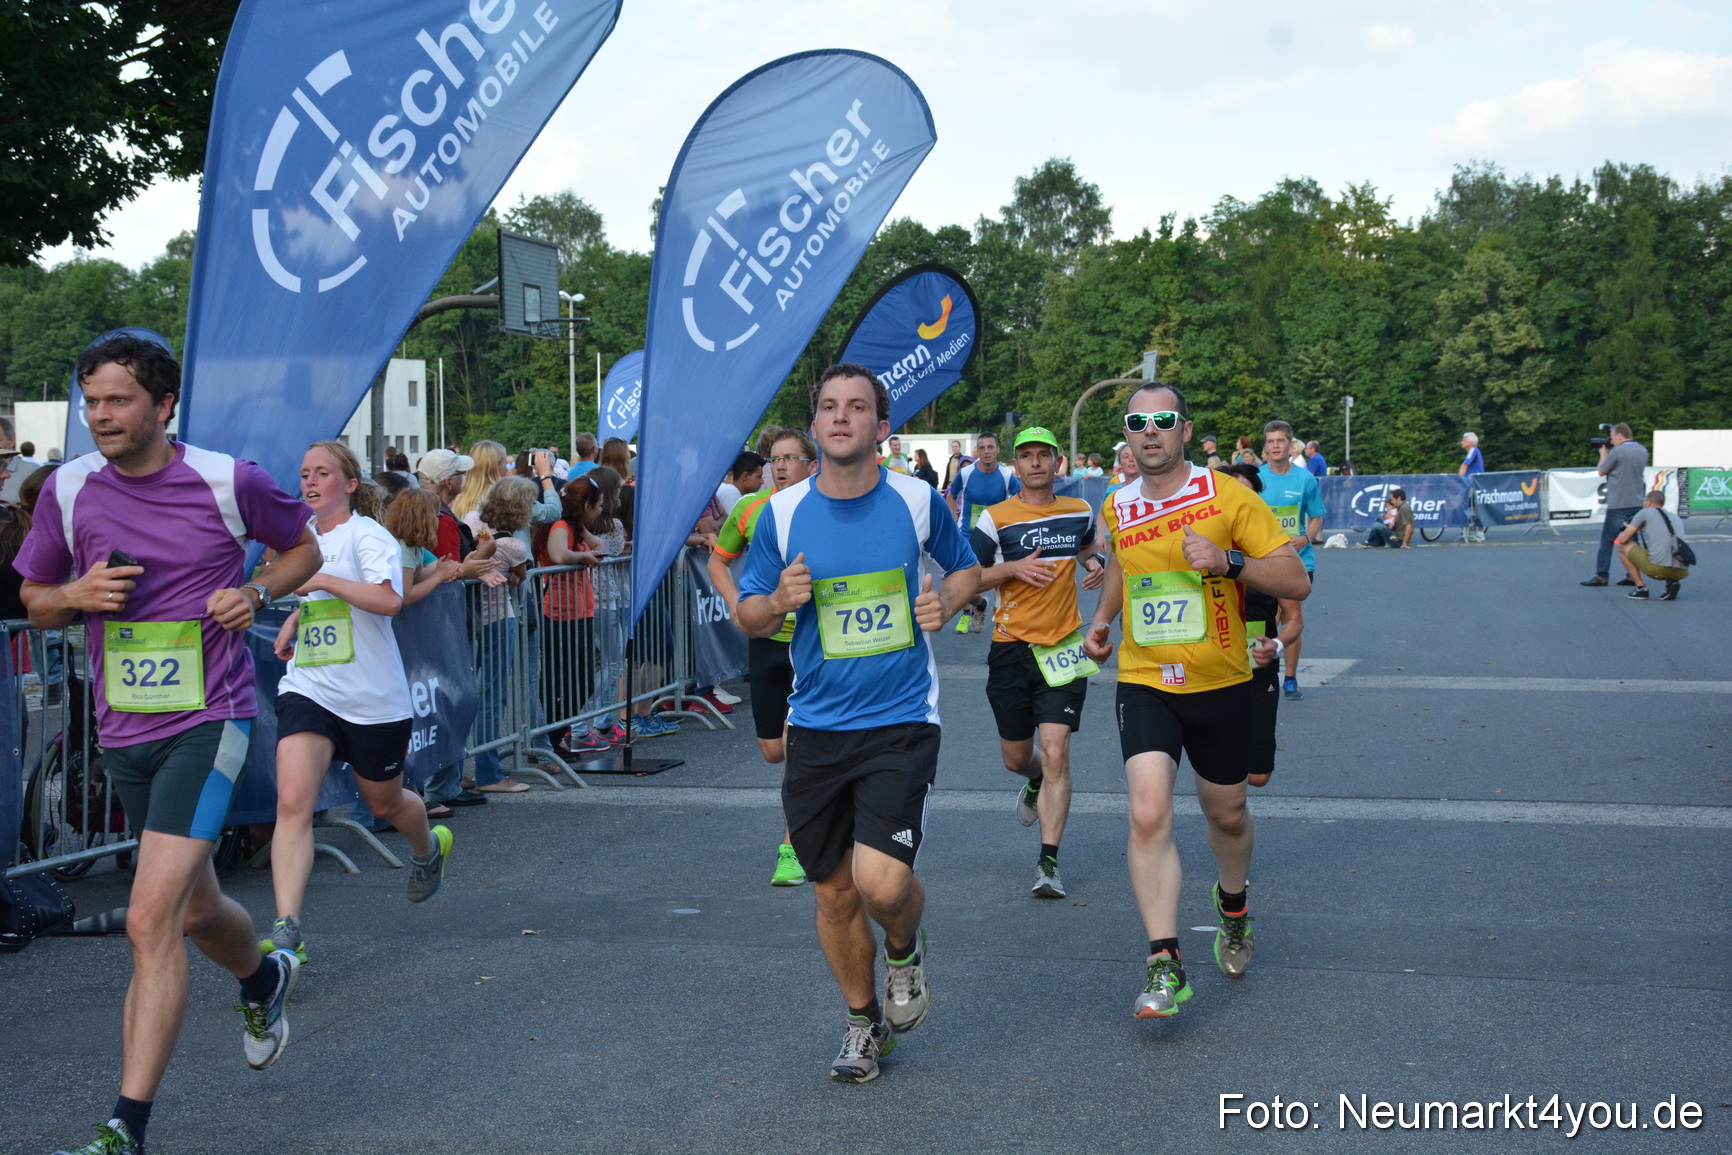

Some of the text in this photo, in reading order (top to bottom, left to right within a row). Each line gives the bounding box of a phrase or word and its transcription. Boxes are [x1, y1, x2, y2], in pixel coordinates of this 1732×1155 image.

[392, 1, 560, 242] AUTOMOBILE
[719, 98, 871, 315] Fischer
[775, 138, 891, 312] AUTOMOBILE
[891, 375, 918, 402] Druck
[937, 332, 971, 367] Medien
[1696, 476, 1732, 496] AOK
[1032, 534, 1077, 547] Fischer
[1119, 504, 1223, 550] MAX BÖGL
[835, 604, 893, 635] 792
[1142, 600, 1188, 626] 927
[304, 625, 337, 648] 436
[121, 658, 180, 687] 322
[1045, 645, 1088, 672] 1634
[891, 834, 913, 848] adidas
